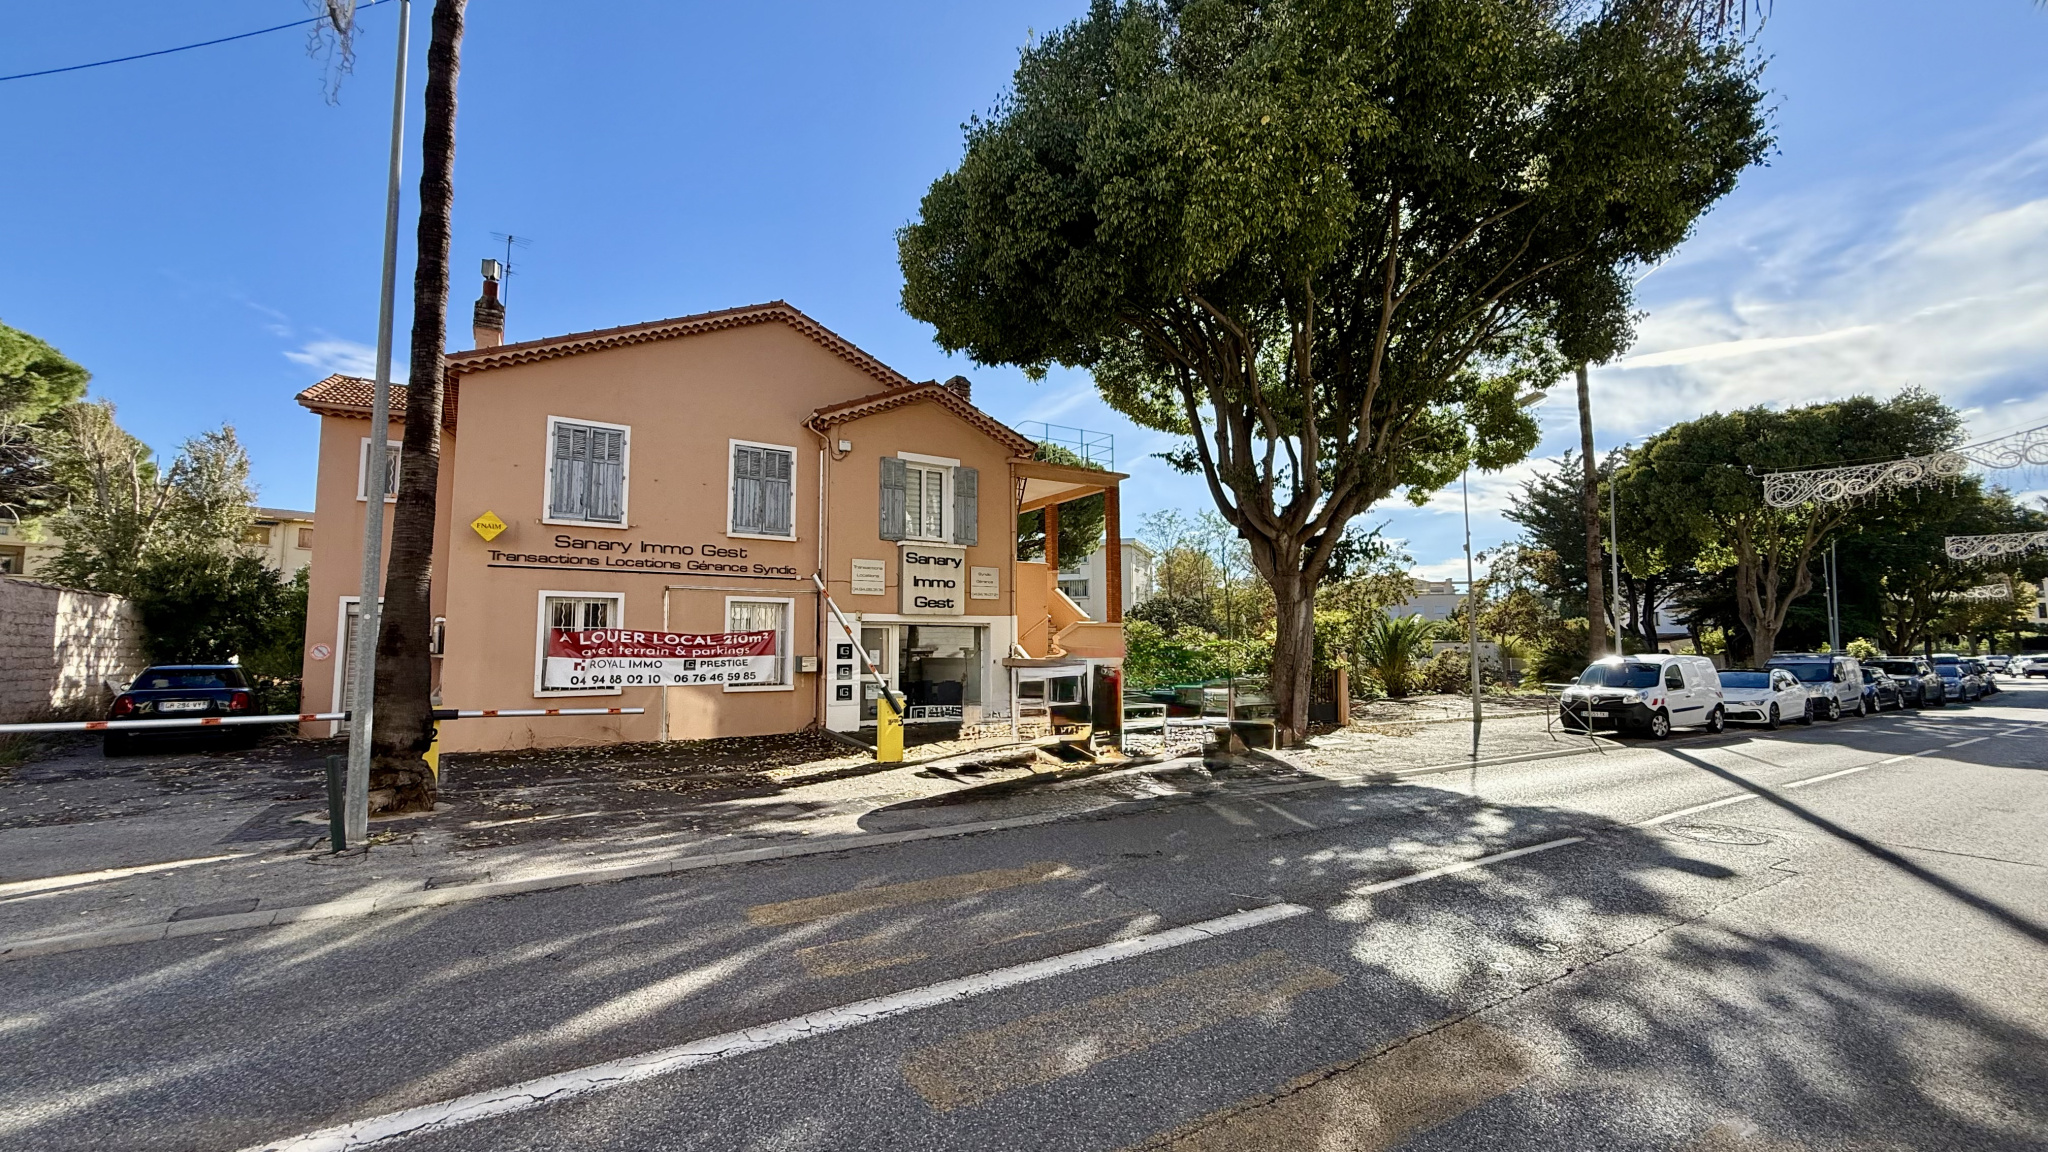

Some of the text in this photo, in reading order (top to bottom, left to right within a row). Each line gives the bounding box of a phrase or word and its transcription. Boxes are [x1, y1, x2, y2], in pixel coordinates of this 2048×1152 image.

[476, 522, 502, 530] FNAIM
[555, 535, 748, 559] Sanary Immo Gest
[488, 550, 797, 575] Transactions Locations Gérance Syndic
[906, 552, 962, 568] Sanary
[913, 575, 956, 588] Immo
[914, 596, 955, 608] Gest
[579, 630, 645, 645] LOUER
[653, 633, 717, 645] LOCAL
[581, 645, 750, 657] avec terrain & parkings
[589, 659, 625, 669] ROYAL
[628, 659, 663, 669] IMMO
[700, 659, 749, 668] PRESTIGE
[570, 674, 661, 685] 04 94 88 02 10
[673, 671, 757, 683] 06 76 46 59 85
[897, 715, 904, 726] 3
